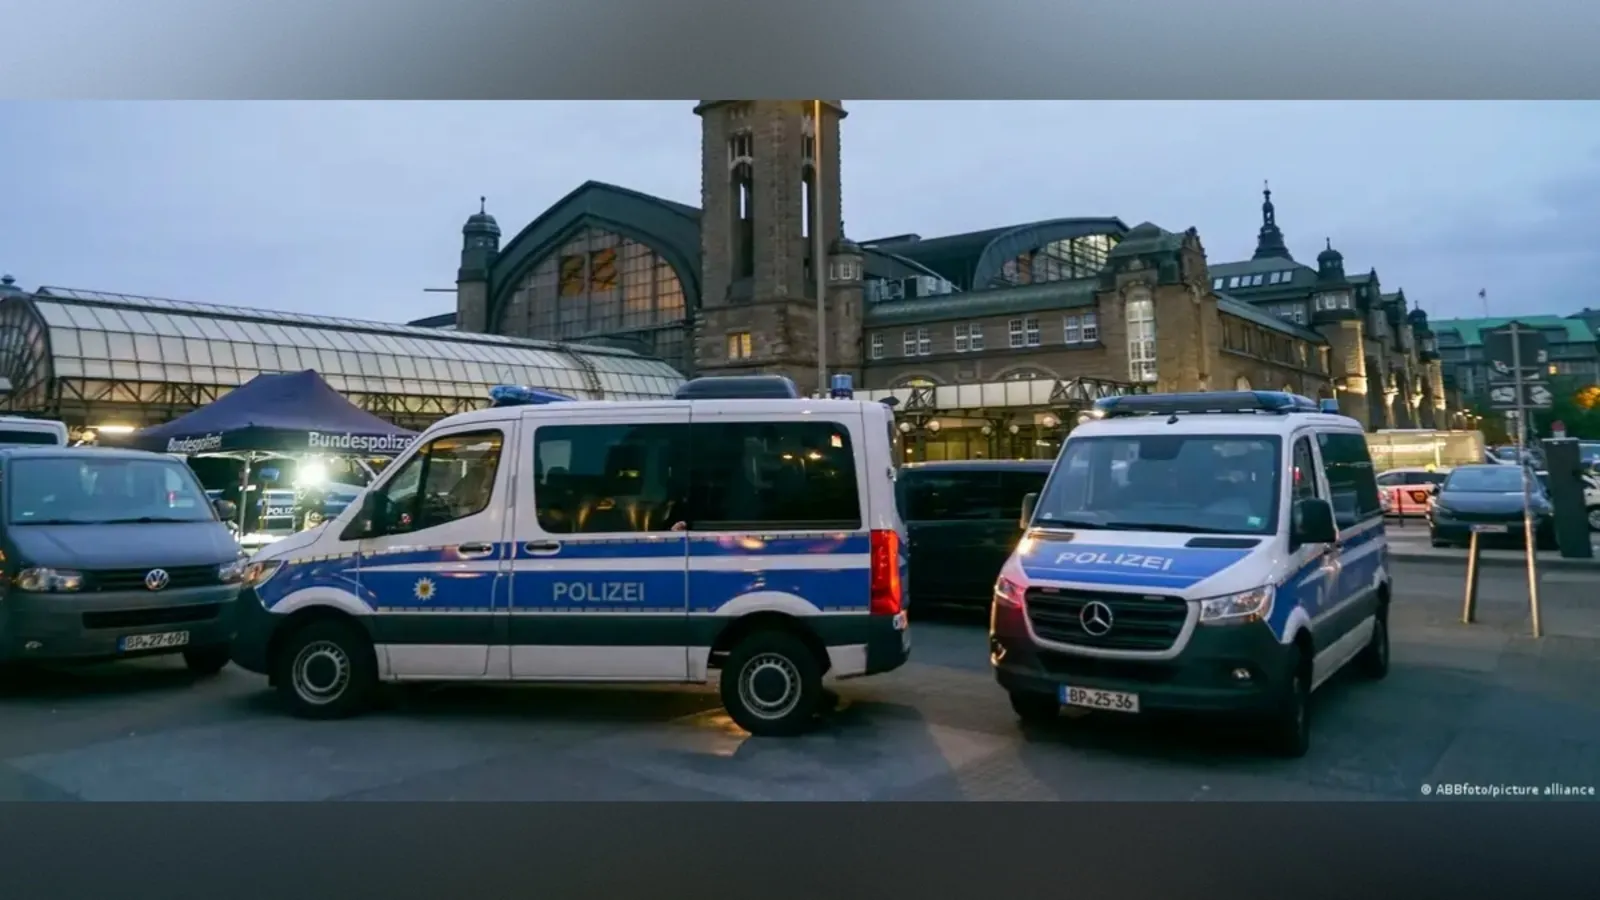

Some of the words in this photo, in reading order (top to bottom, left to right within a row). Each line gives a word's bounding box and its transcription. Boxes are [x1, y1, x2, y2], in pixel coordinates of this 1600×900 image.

[267, 506, 294, 516] POLIZ
[1055, 551, 1174, 571] POLIZEI
[552, 581, 645, 602] POLIZEI
